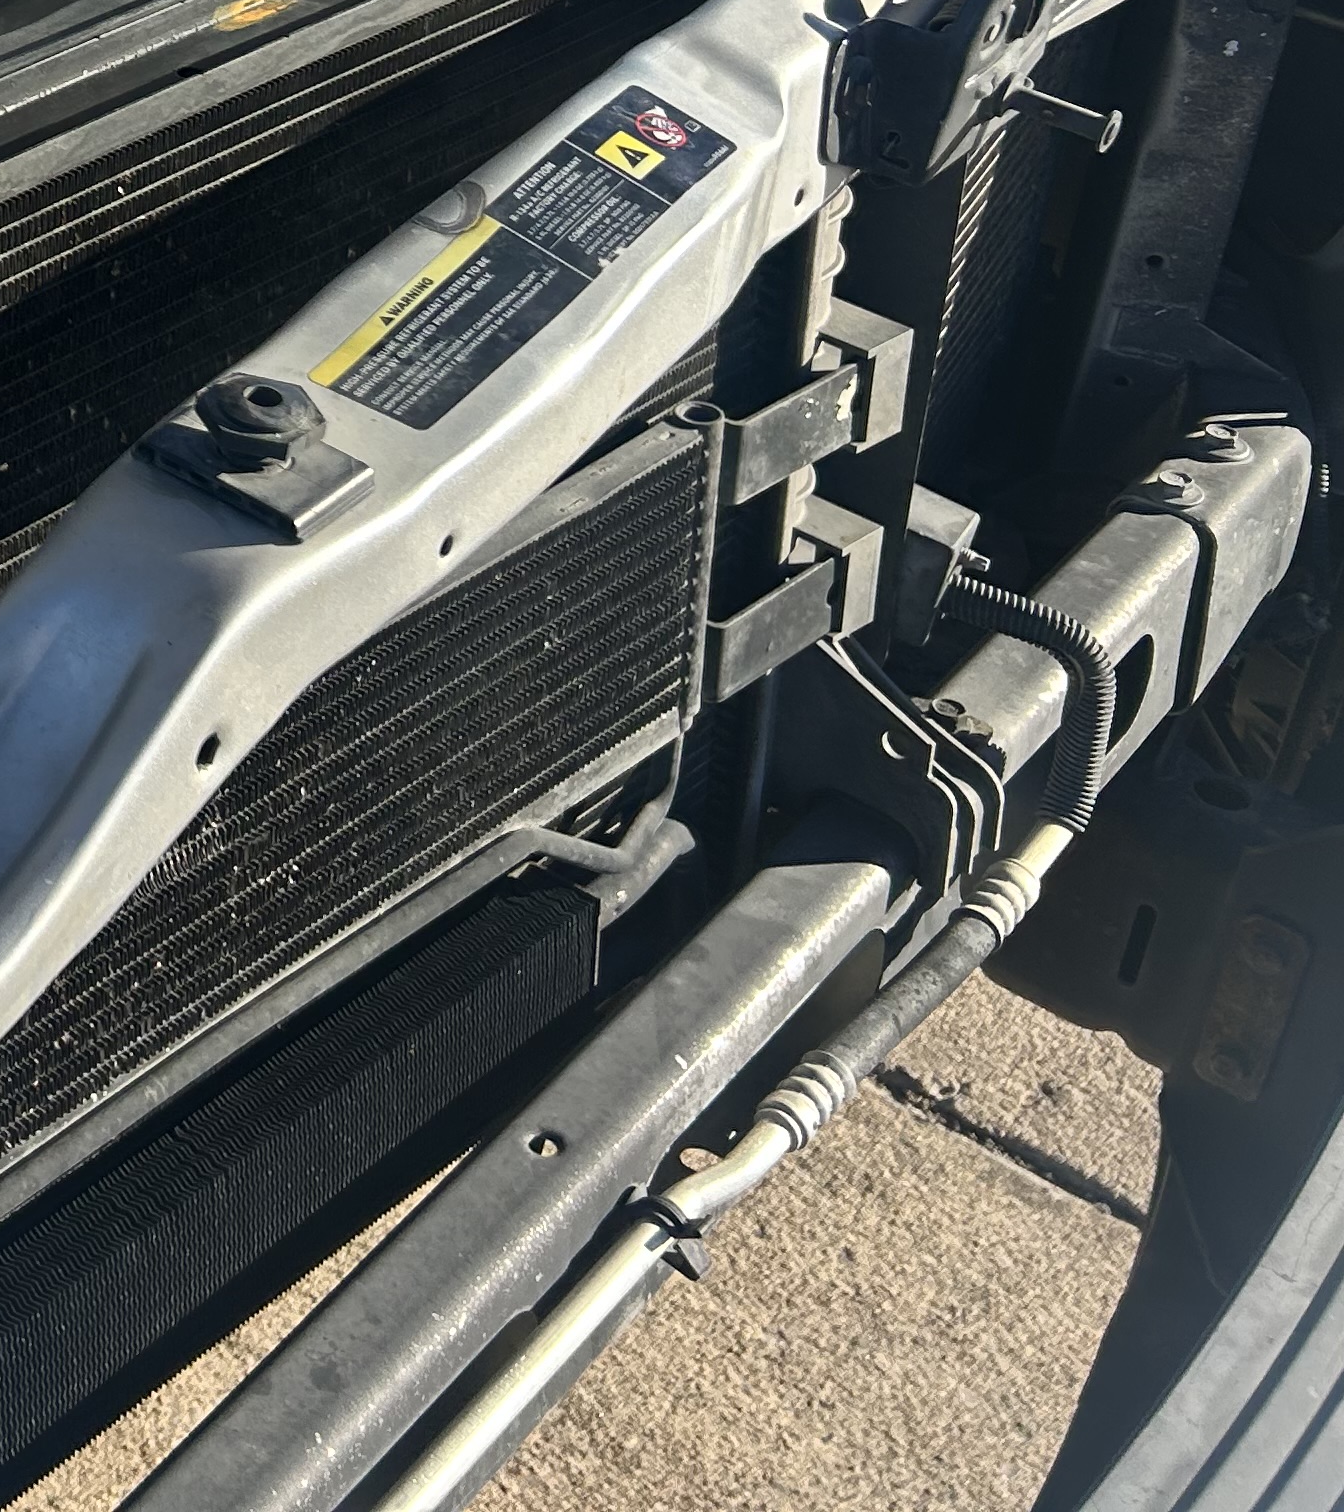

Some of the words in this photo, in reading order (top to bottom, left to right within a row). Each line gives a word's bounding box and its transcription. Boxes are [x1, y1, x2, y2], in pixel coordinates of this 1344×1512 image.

[511, 161, 557, 199] ATTENTION
[529, 190, 546, 202] A/C
[540, 156, 583, 192] REFRIGERANT
[527, 192, 559, 218] FACTORY
[566, 204, 611, 242] COMPRESSOR
[385, 276, 435, 317] WARNING
[393, 298, 445, 342] REFRIGERANT
[439, 273, 471, 299] SYSTEM
[465, 264, 481, 276] TO
[475, 256, 490, 267] BE
[352, 365, 391, 397] SERVICED
[386, 357, 401, 367] BY
[395, 323, 438, 359] QUALIFIED
[431, 288, 476, 325] PERSONNEL
